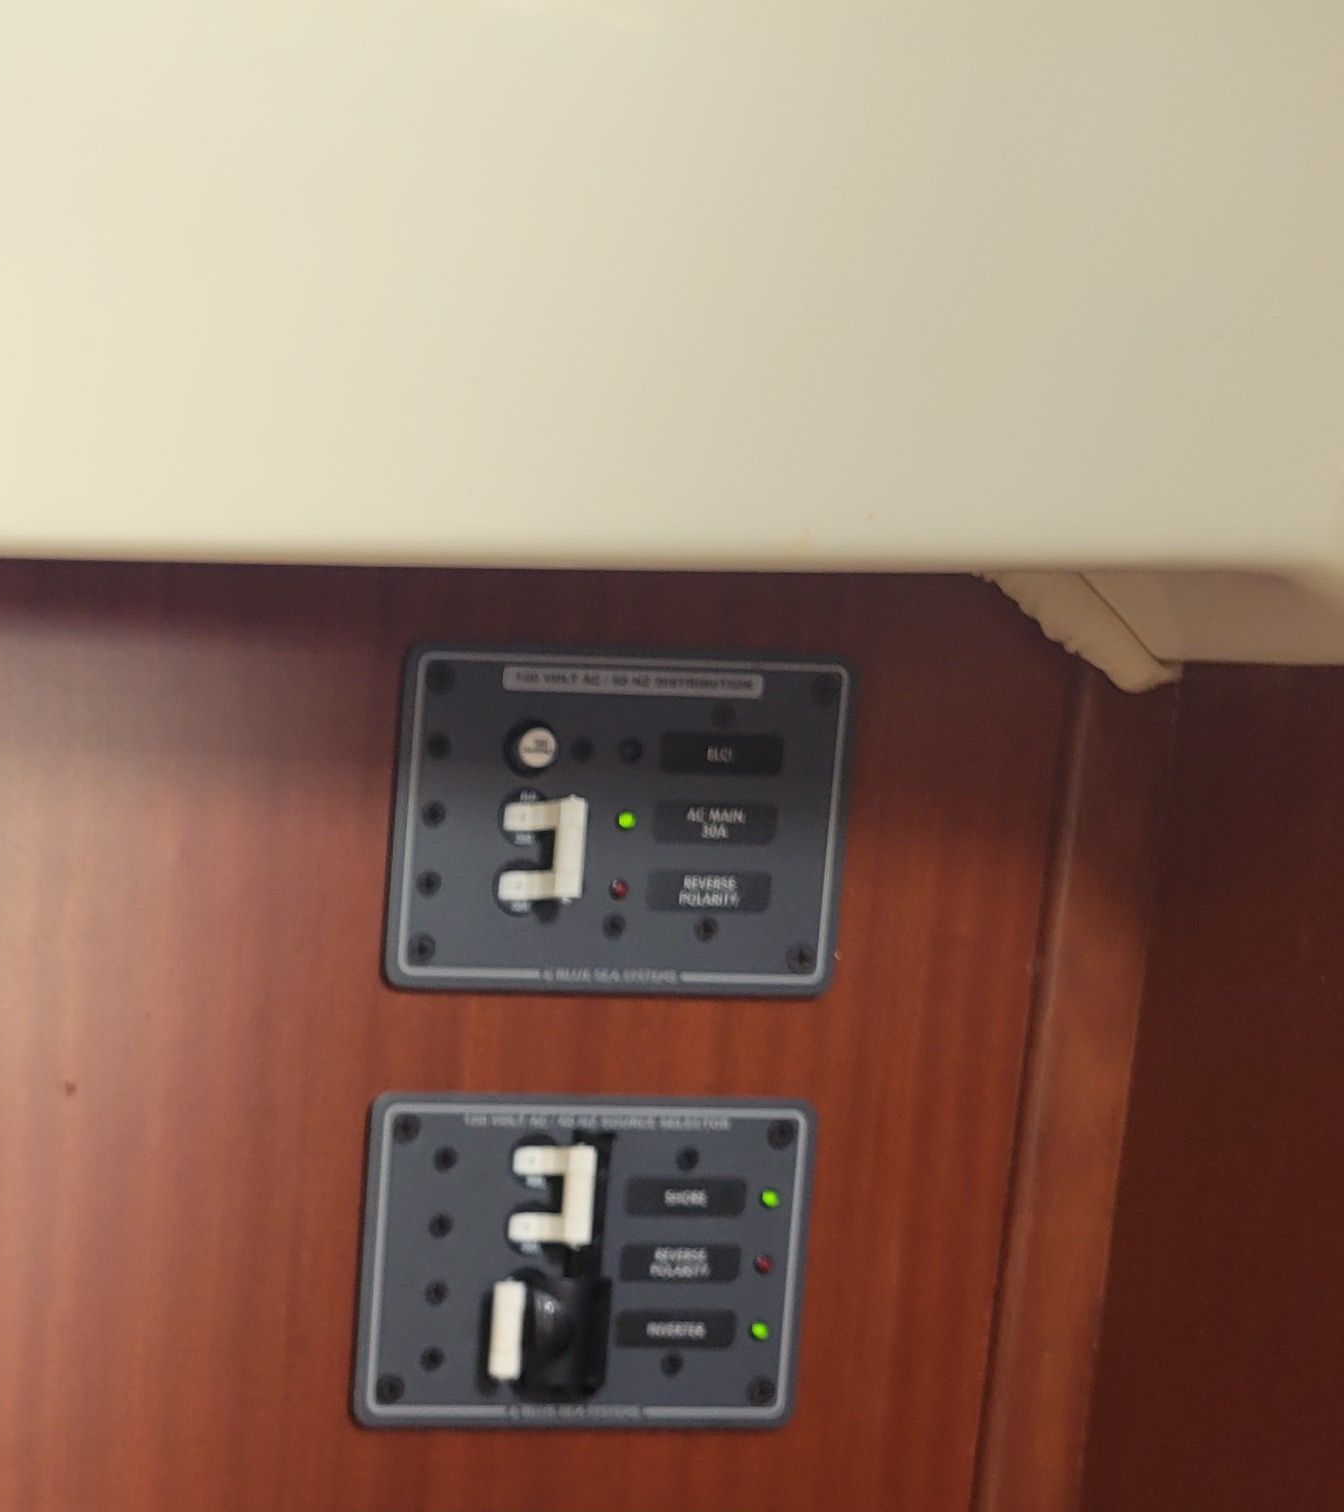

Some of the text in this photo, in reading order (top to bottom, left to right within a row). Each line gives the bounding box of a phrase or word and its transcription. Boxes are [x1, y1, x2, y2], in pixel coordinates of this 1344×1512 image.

[686, 806, 707, 822] AC
[683, 874, 738, 891] REVERSE
[678, 891, 740, 908] POLARITY
